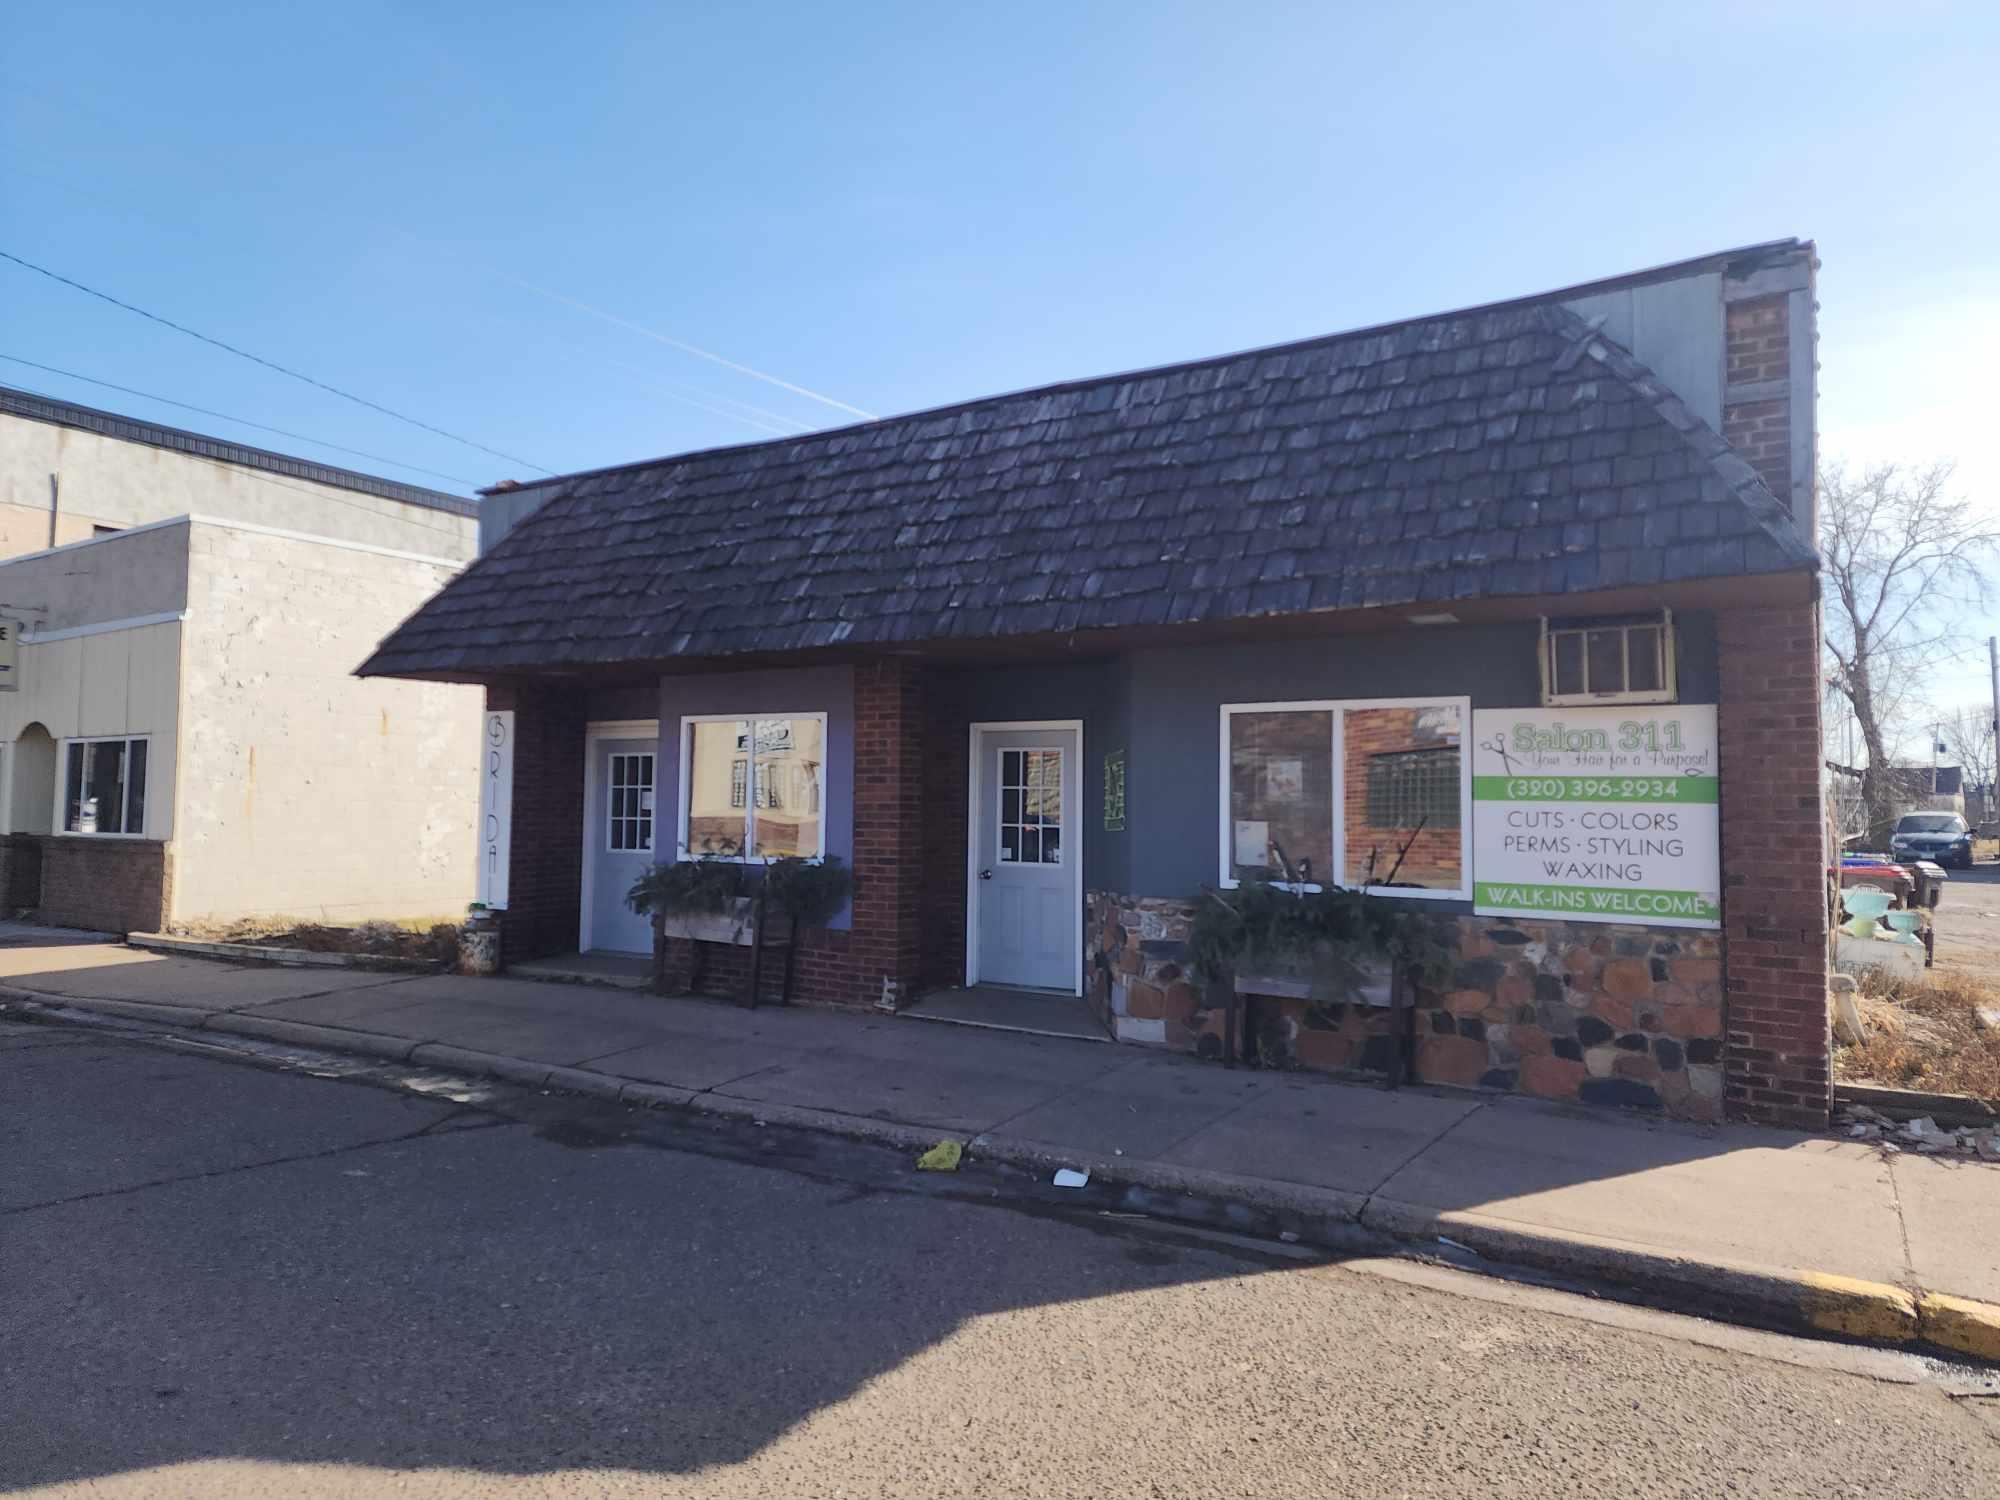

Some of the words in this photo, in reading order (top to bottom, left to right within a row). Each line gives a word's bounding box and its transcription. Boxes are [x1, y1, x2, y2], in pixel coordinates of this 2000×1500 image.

[1511, 722, 1610, 752] Salon
[1618, 720, 1685, 752] 311
[1633, 757, 1641, 766] a
[1506, 780, 1565, 799] (320)
[1571, 780, 1679, 798] 396-2934
[1507, 811, 1564, 828] CUTS
[1580, 812, 1678, 831] COLORS
[1504, 835, 1570, 852] PERMS
[1587, 838, 1684, 857] STYLING
[1543, 861, 1642, 881] WAXING
[1487, 887, 1586, 908] WALK-INS
[1592, 894, 1706, 915] WELCOME
